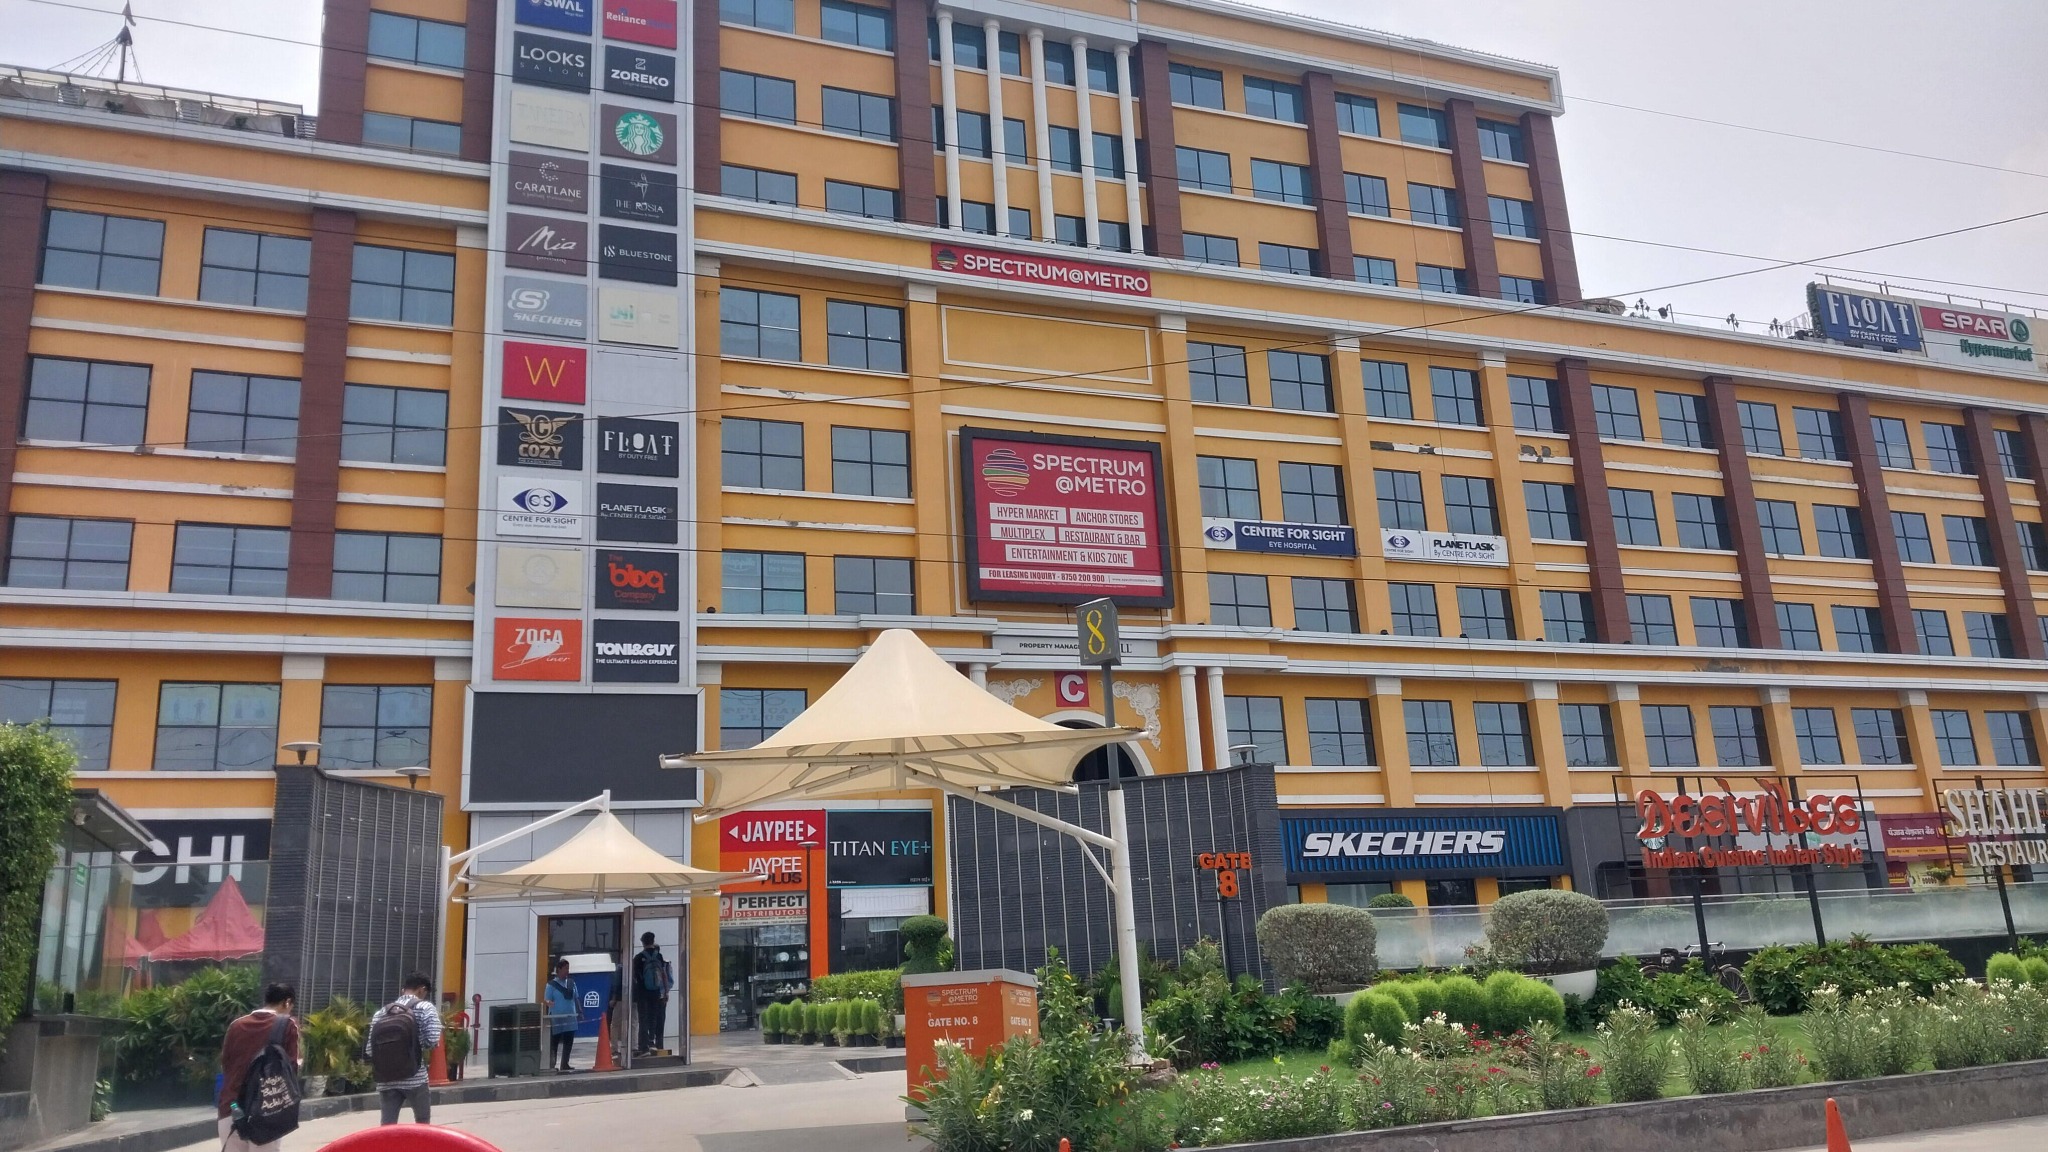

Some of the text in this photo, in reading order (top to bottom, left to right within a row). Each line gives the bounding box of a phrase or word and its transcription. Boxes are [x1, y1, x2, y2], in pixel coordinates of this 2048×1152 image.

[606, 12, 646, 26] Reliance
[520, 46, 584, 68] LOOKS
[520, 62, 584, 78] SALON
[611, 69, 668, 87] ZOREKO
[515, 182, 582, 198] CARATLANE
[615, 199, 632, 210] THE
[518, 226, 577, 251] Mia
[619, 249, 672, 262] BLUESTONE
[963, 254, 1148, 292] SPECTRUM@METRO
[513, 312, 583, 328] SKECHERS
[1826, 292, 1910, 336] FLOAT
[1940, 312, 2007, 336] SPAR
[1960, 339, 2033, 362] Hypermarket
[524, 356, 566, 388] W
[604, 430, 673, 456] FLOAT
[518, 444, 563, 460] COZY
[1033, 454, 1145, 477] SPECTRUM
[1055, 476, 1146, 496] @METRO
[529, 494, 552, 507] CS
[601, 503, 666, 514] PLANETLASIK
[502, 514, 533, 522] CENTRE
[997, 506, 1059, 520] HYPER MARKET
[1076, 512, 1139, 525] ANCHOR STORES
[1001, 527, 1045, 540] MULTIPLEX
[1065, 531, 1140, 545] RESTAURANT & BAR
[1241, 526, 1284, 538] CENTRE
[1288, 529, 1310, 539] FOR
[1311, 530, 1345, 541] SIGHT
[1284, 542, 1317, 550] HOSPITAL
[1433, 539, 1495, 551] PLANETLASIK
[1012, 548, 1128, 564] ENTERTAINMENT & KIDS ZONE
[1442, 550, 1464, 558] CENTRE
[1478, 552, 1494, 560] SIGHT
[608, 562, 666, 593] bbq
[989, 570, 1001, 578] FOR
[1002, 570, 1028, 579] LEASING
[1030, 572, 1056, 580] INQUIRY
[1061, 573, 1077, 581] 8750
[1078, 574, 1091, 582] 200
[614, 590, 656, 600] Company
[515, 628, 564, 645] ZOCA
[1086, 610, 1106, 655] 8
[596, 642, 674, 656] TONI&GUY
[1061, 674, 1085, 702] C
[1944, 789, 2046, 837] SHAHI
[742, 820, 804, 842] JAYPEE
[830, 841, 931, 856] TITAN EYE+
[1303, 830, 1506, 857] SKECHERS
[1199, 852, 1252, 869] GATE
[1641, 843, 1864, 869] Indian Cuisine Indian Style
[1968, 840, 2048, 867] RESTAUR
[742, 856, 802, 874] JAYPEE
[1219, 871, 1238, 897] 8
[738, 895, 804, 909] PERFECT
[736, 909, 807, 918] DISTRIBUTORS
[942, 988, 977, 996] SPECTRUM
[949, 995, 977, 1003] @METRO
[928, 1016, 978, 1027] GATE NO. 8
